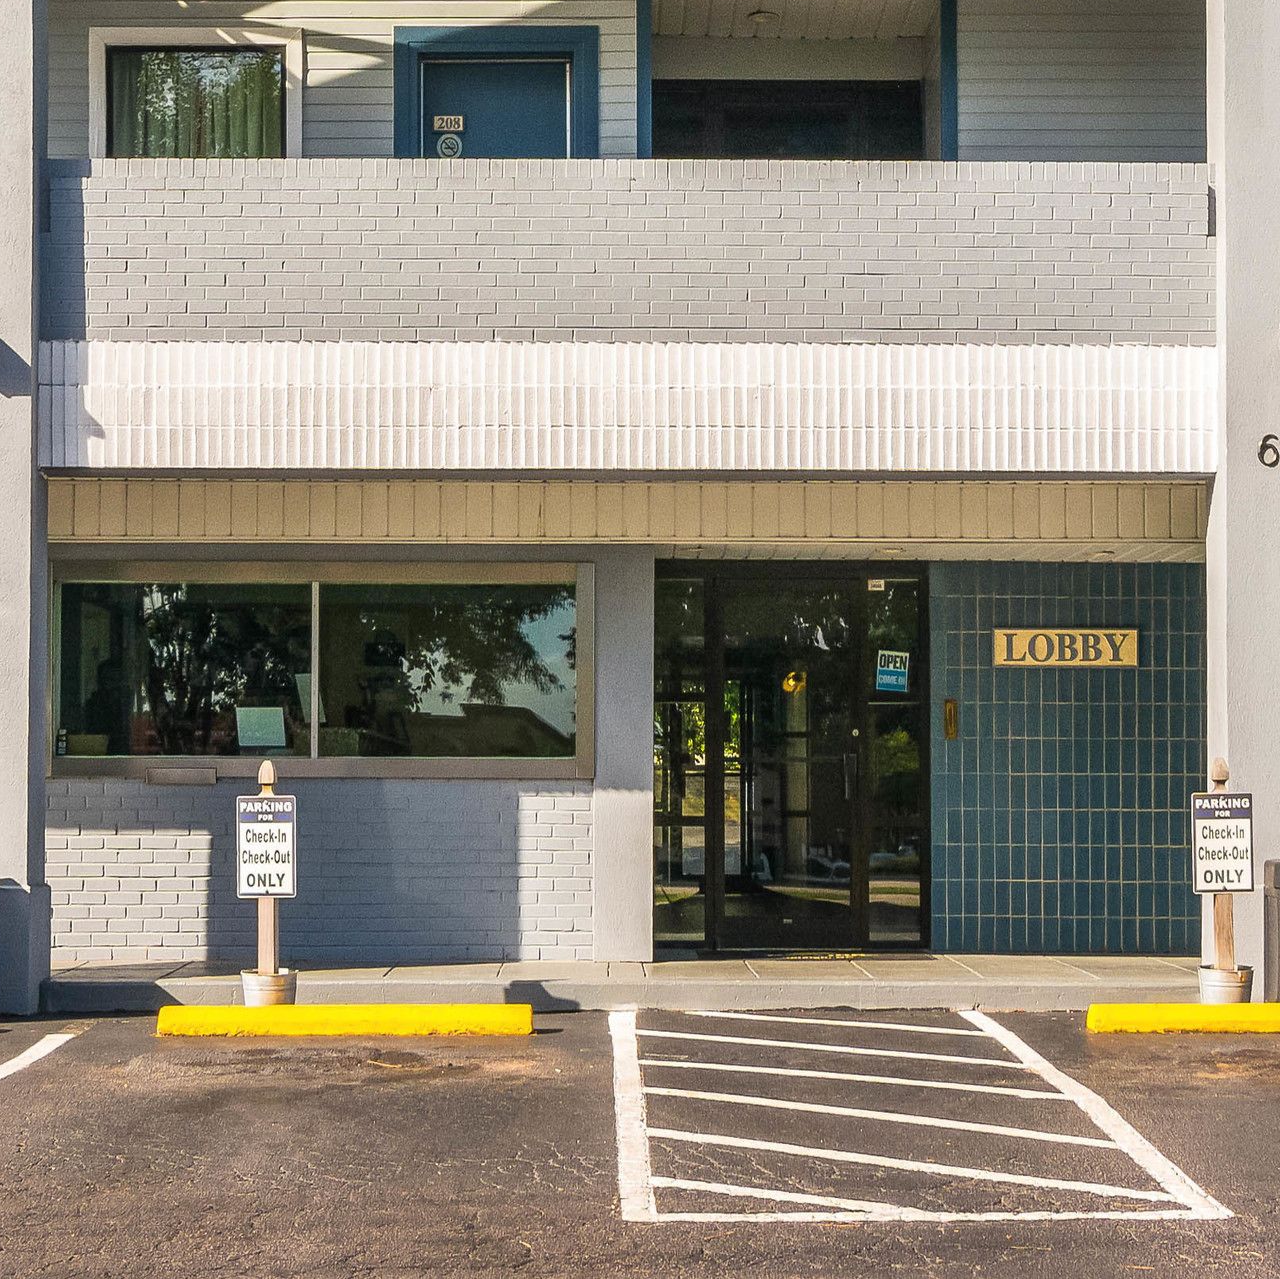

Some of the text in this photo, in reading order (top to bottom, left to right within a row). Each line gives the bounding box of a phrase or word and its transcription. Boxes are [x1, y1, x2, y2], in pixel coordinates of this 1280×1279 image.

[437, 117, 461, 130] 208
[1003, 633, 1129, 663] LOBBY
[879, 653, 908, 671] OPEN
[240, 801, 293, 813] PARKING
[1195, 797, 1251, 809] PARKING
[1215, 810, 1231, 818] FOR
[245, 829, 287, 843] Check-In
[1201, 825, 1245, 840] Check-In
[242, 850, 291, 864] Check-Out
[1198, 846, 1249, 861] Check-Out
[247, 873, 286, 887] ONLY
[1204, 869, 1244, 884] ONLY
